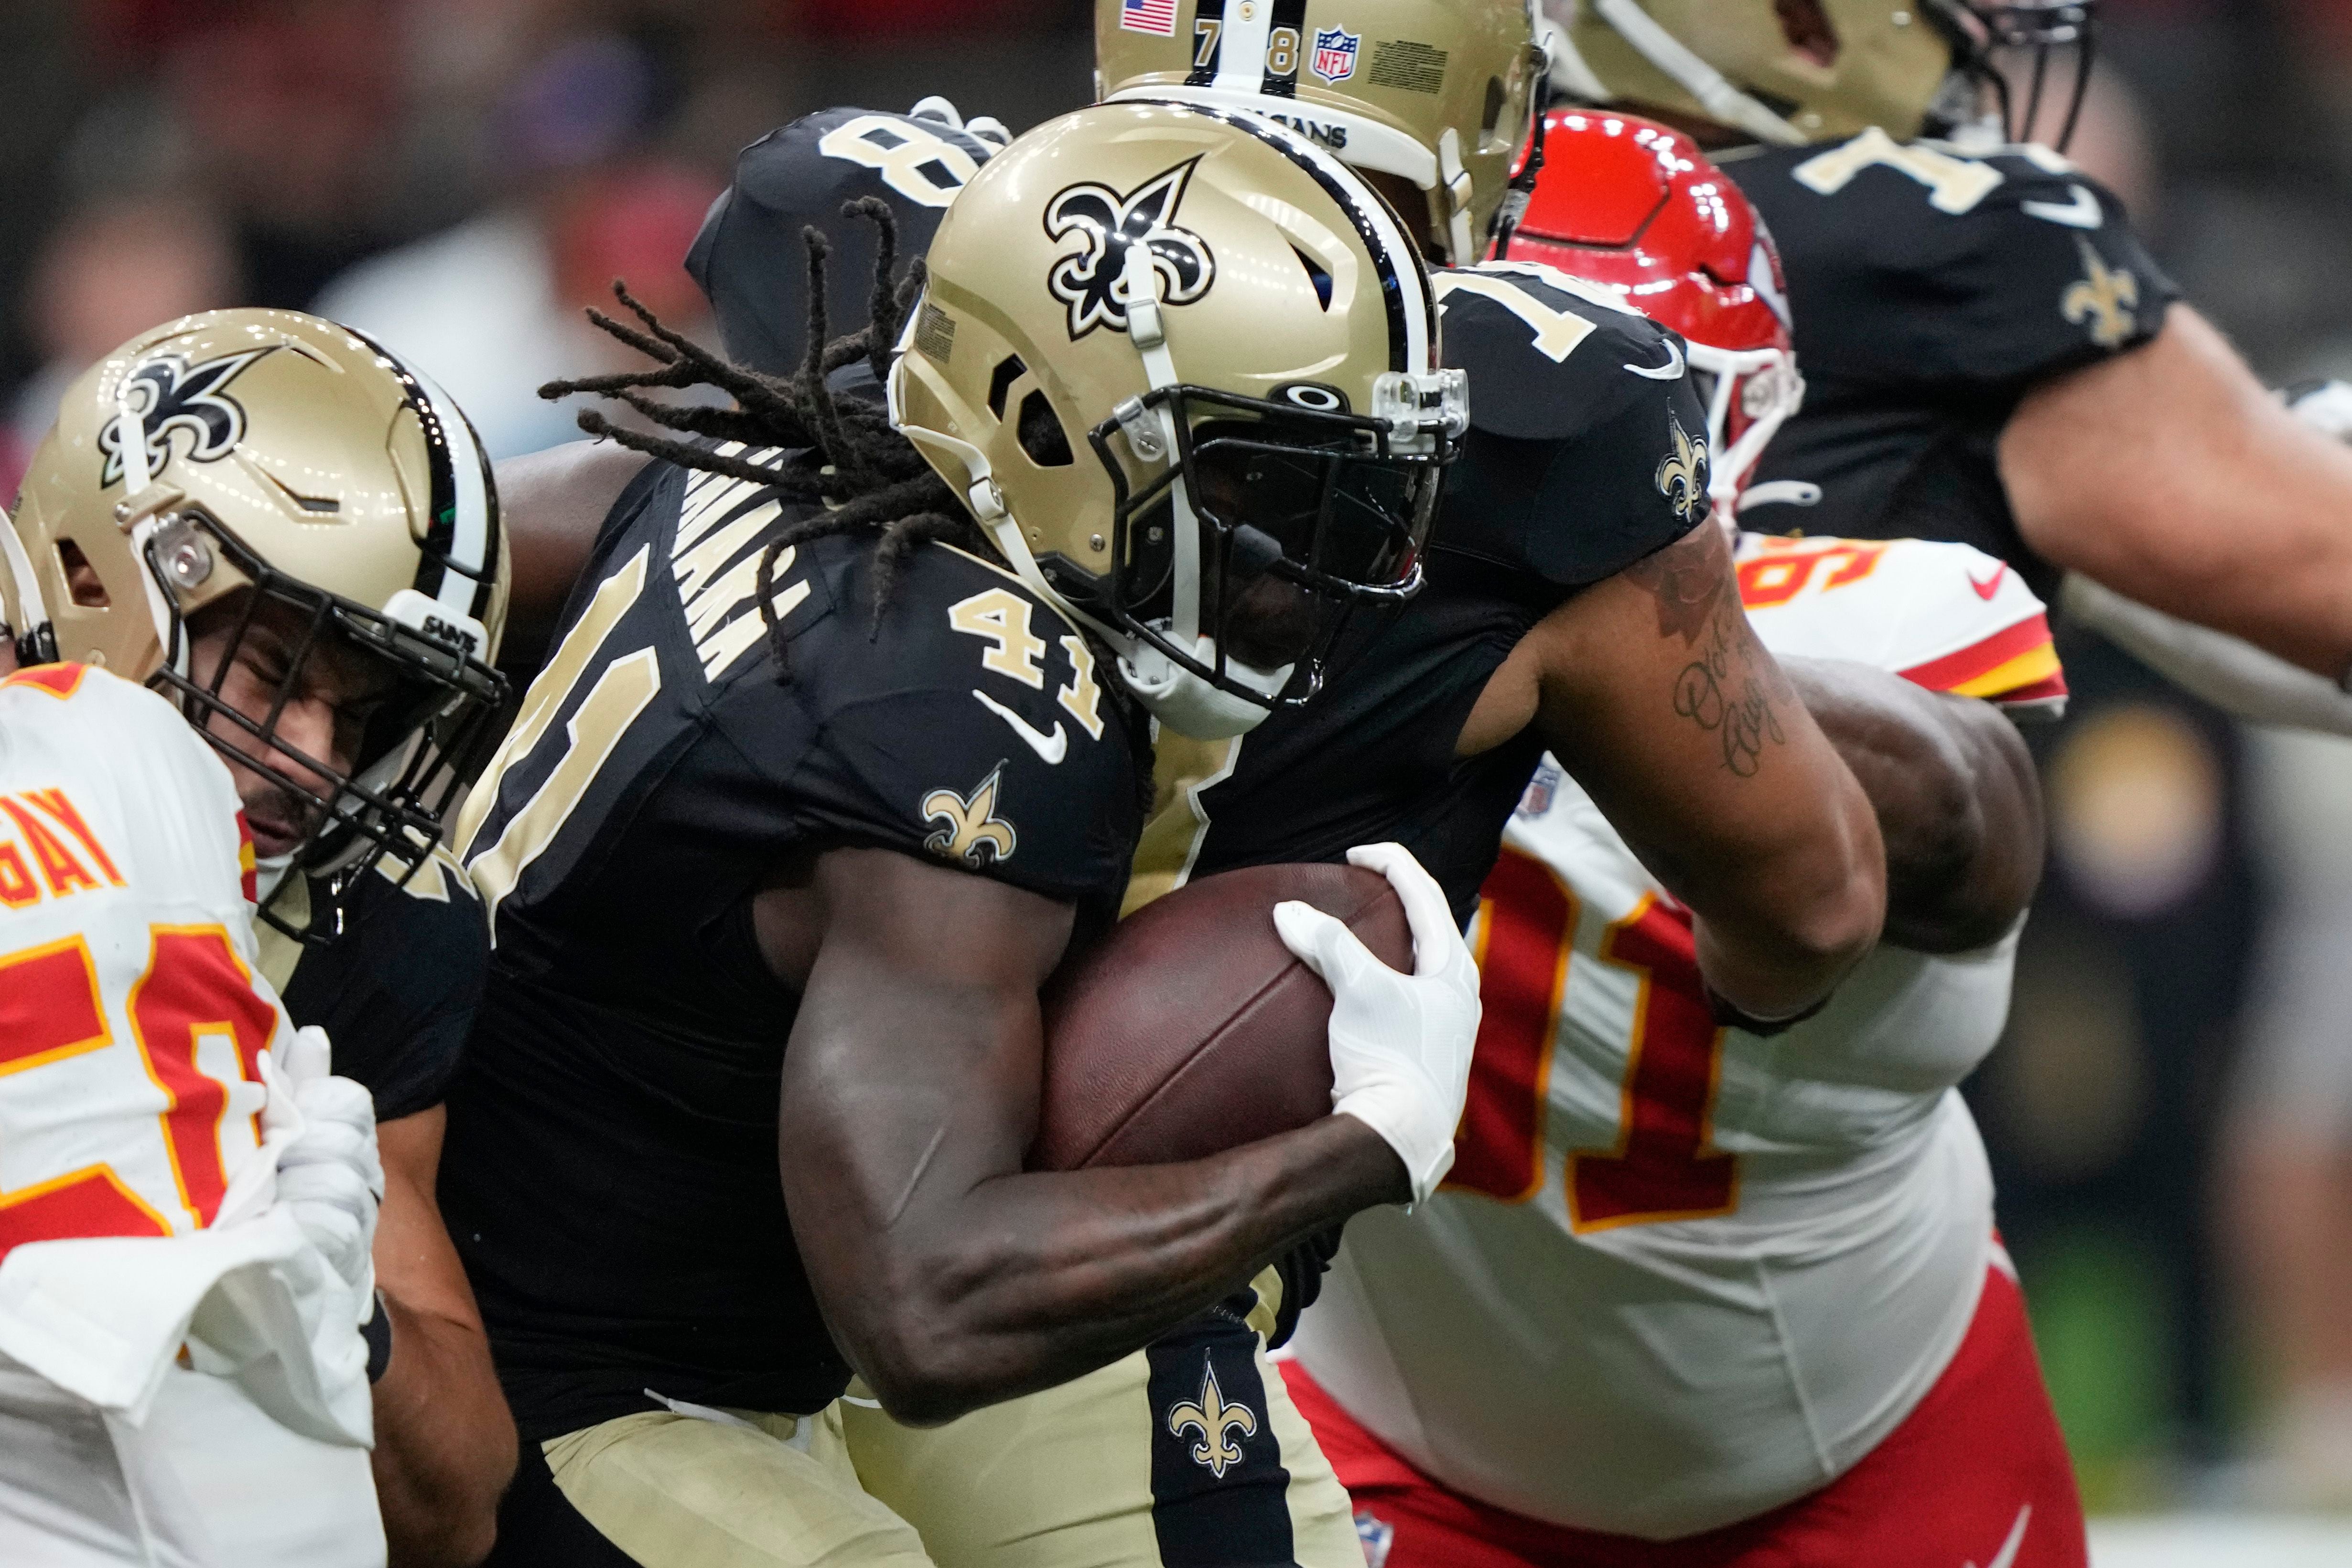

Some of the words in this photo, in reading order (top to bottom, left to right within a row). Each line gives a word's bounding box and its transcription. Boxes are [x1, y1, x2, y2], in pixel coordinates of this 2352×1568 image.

[1195, 18, 1223, 66] 7
[1265, 27, 1301, 76] 8
[1316, 50, 1350, 75] NFL
[947, 587, 1105, 741] 41
